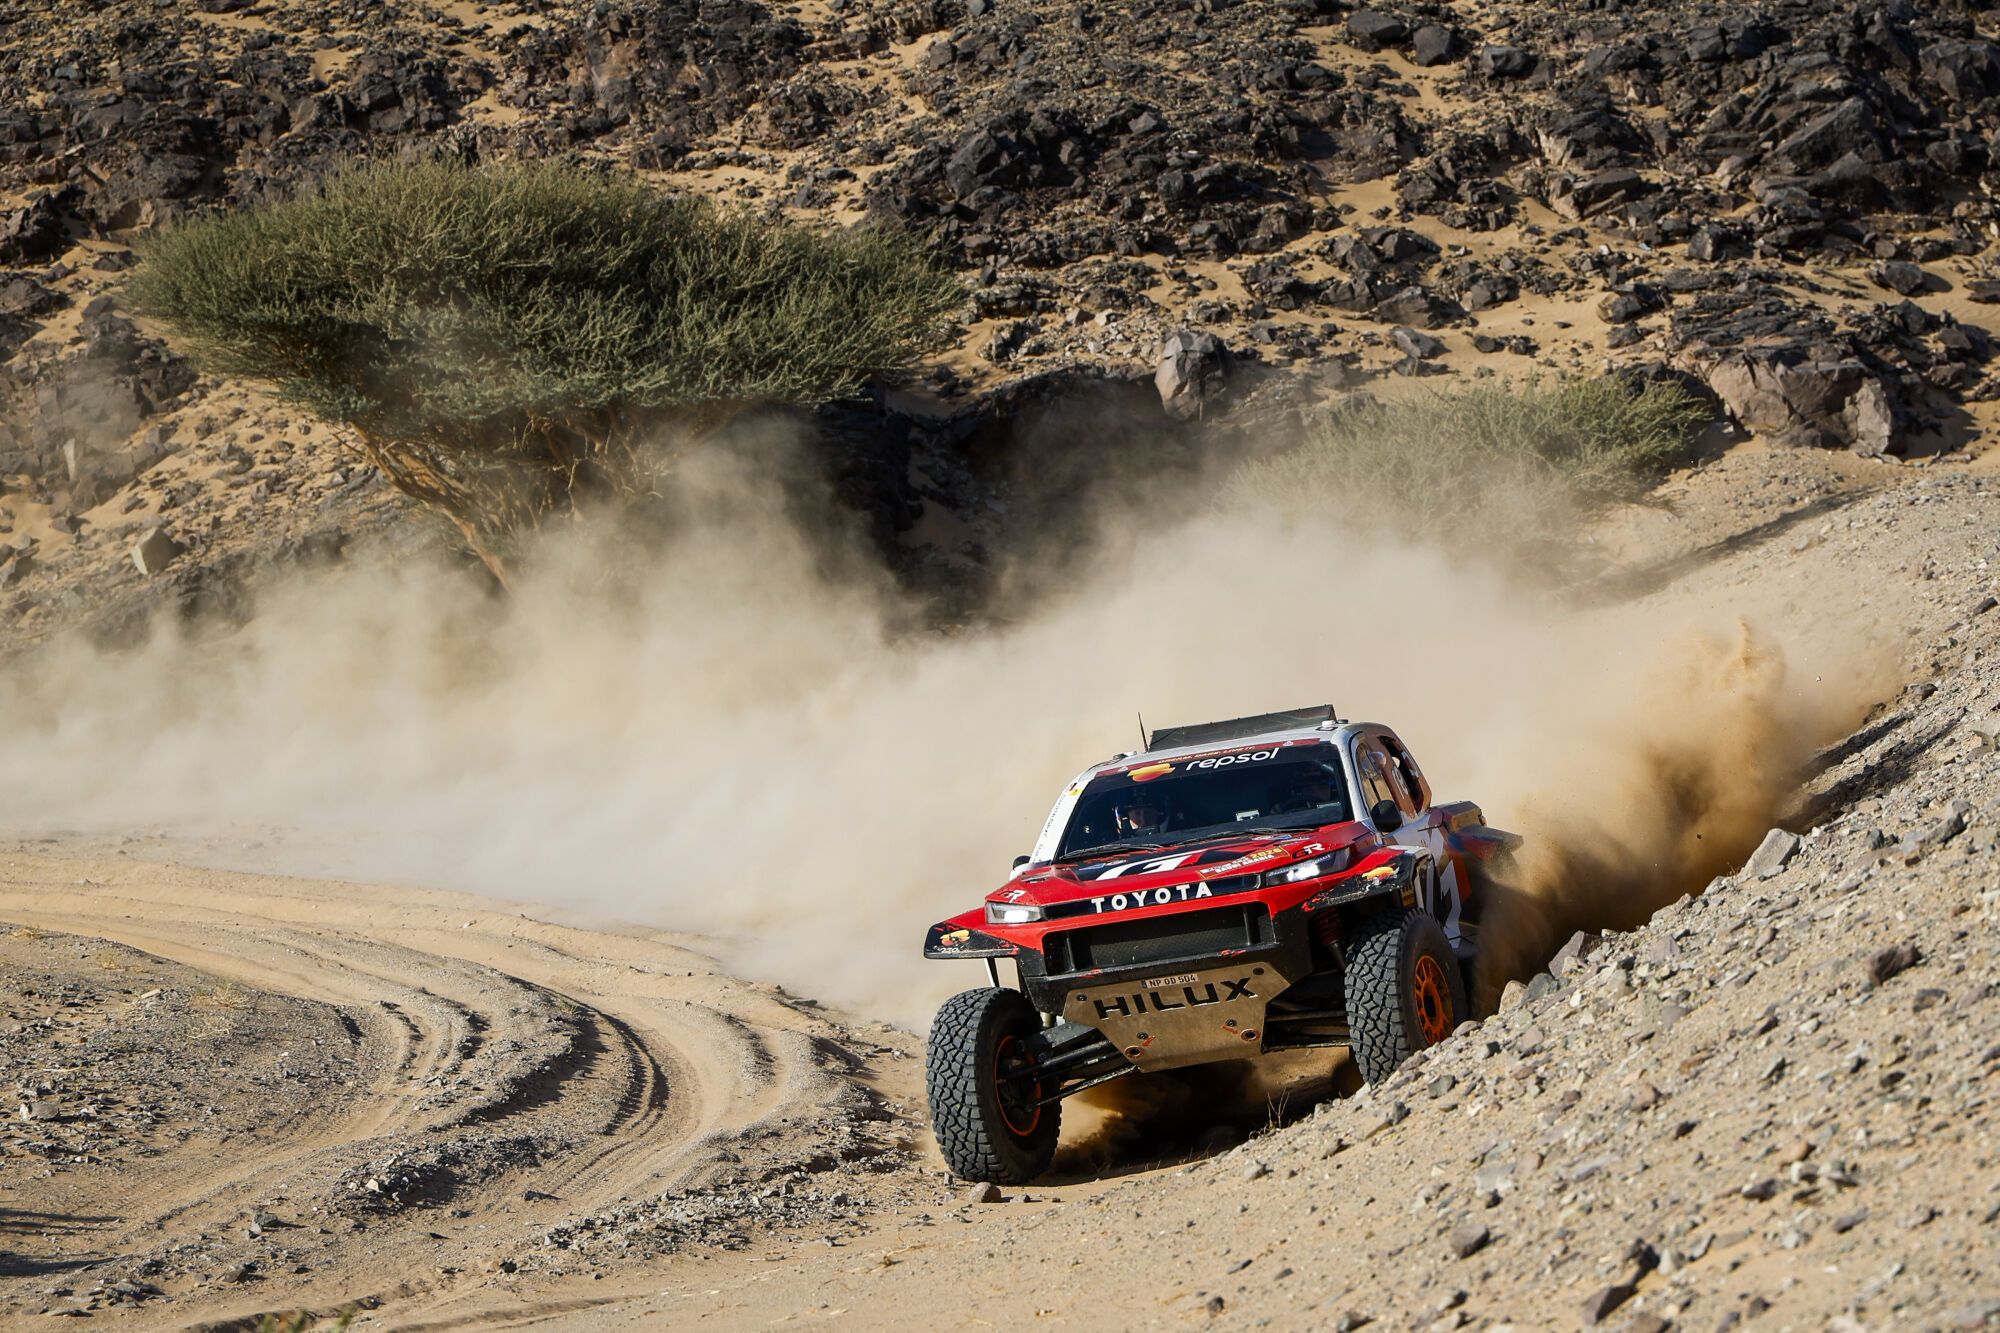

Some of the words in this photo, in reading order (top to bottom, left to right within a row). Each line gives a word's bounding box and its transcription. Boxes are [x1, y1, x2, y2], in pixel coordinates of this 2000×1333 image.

[1185, 748, 1279, 771] repsol
[1091, 881, 1213, 914] TOYOTA
[1149, 978, 1162, 988] NP
[1178, 974, 1196, 984] 504
[1093, 977, 1259, 1021] HILUX
